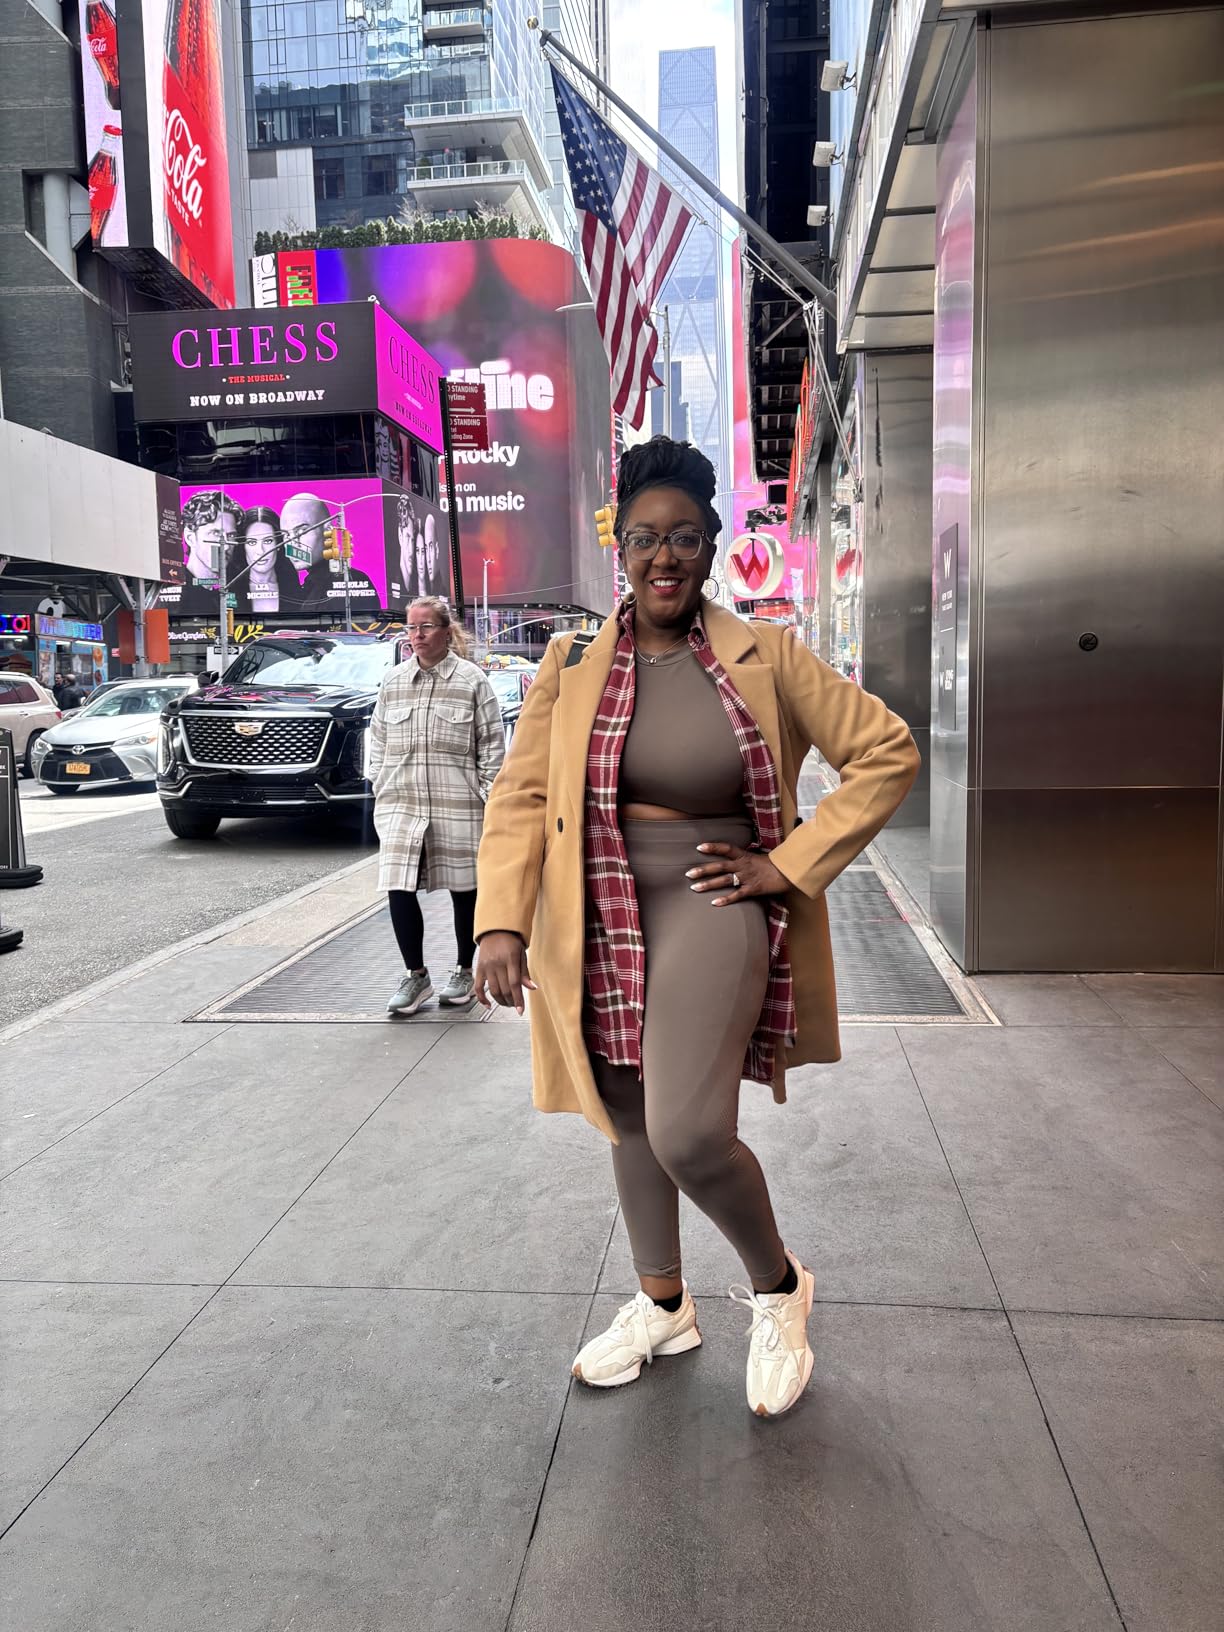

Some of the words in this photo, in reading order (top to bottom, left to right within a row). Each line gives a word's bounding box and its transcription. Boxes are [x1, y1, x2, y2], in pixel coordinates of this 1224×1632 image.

[171, 190, 190, 227] TASTE
[171, 321, 339, 369] CHESS
[228, 376, 245, 384] THE
[247, 373, 285, 383] MUSICAL
[389, 336, 435, 404] CHESS
[190, 394, 221, 407] NOW
[225, 393, 245, 405] ON
[249, 389, 325, 404] BROADWAY
[448, 394, 466, 402] nytime
[451, 385, 479, 394] STANDING
[453, 418, 481, 426] STANDING
[453, 441, 520, 467] Rocky
[463, 483, 477, 492] on
[466, 490, 525, 511] music
[730, 550, 770, 585] W
[944, 548, 952, 579] W
[247, 591, 279, 600] MICHELE
[255, 583, 270, 591] LEA
